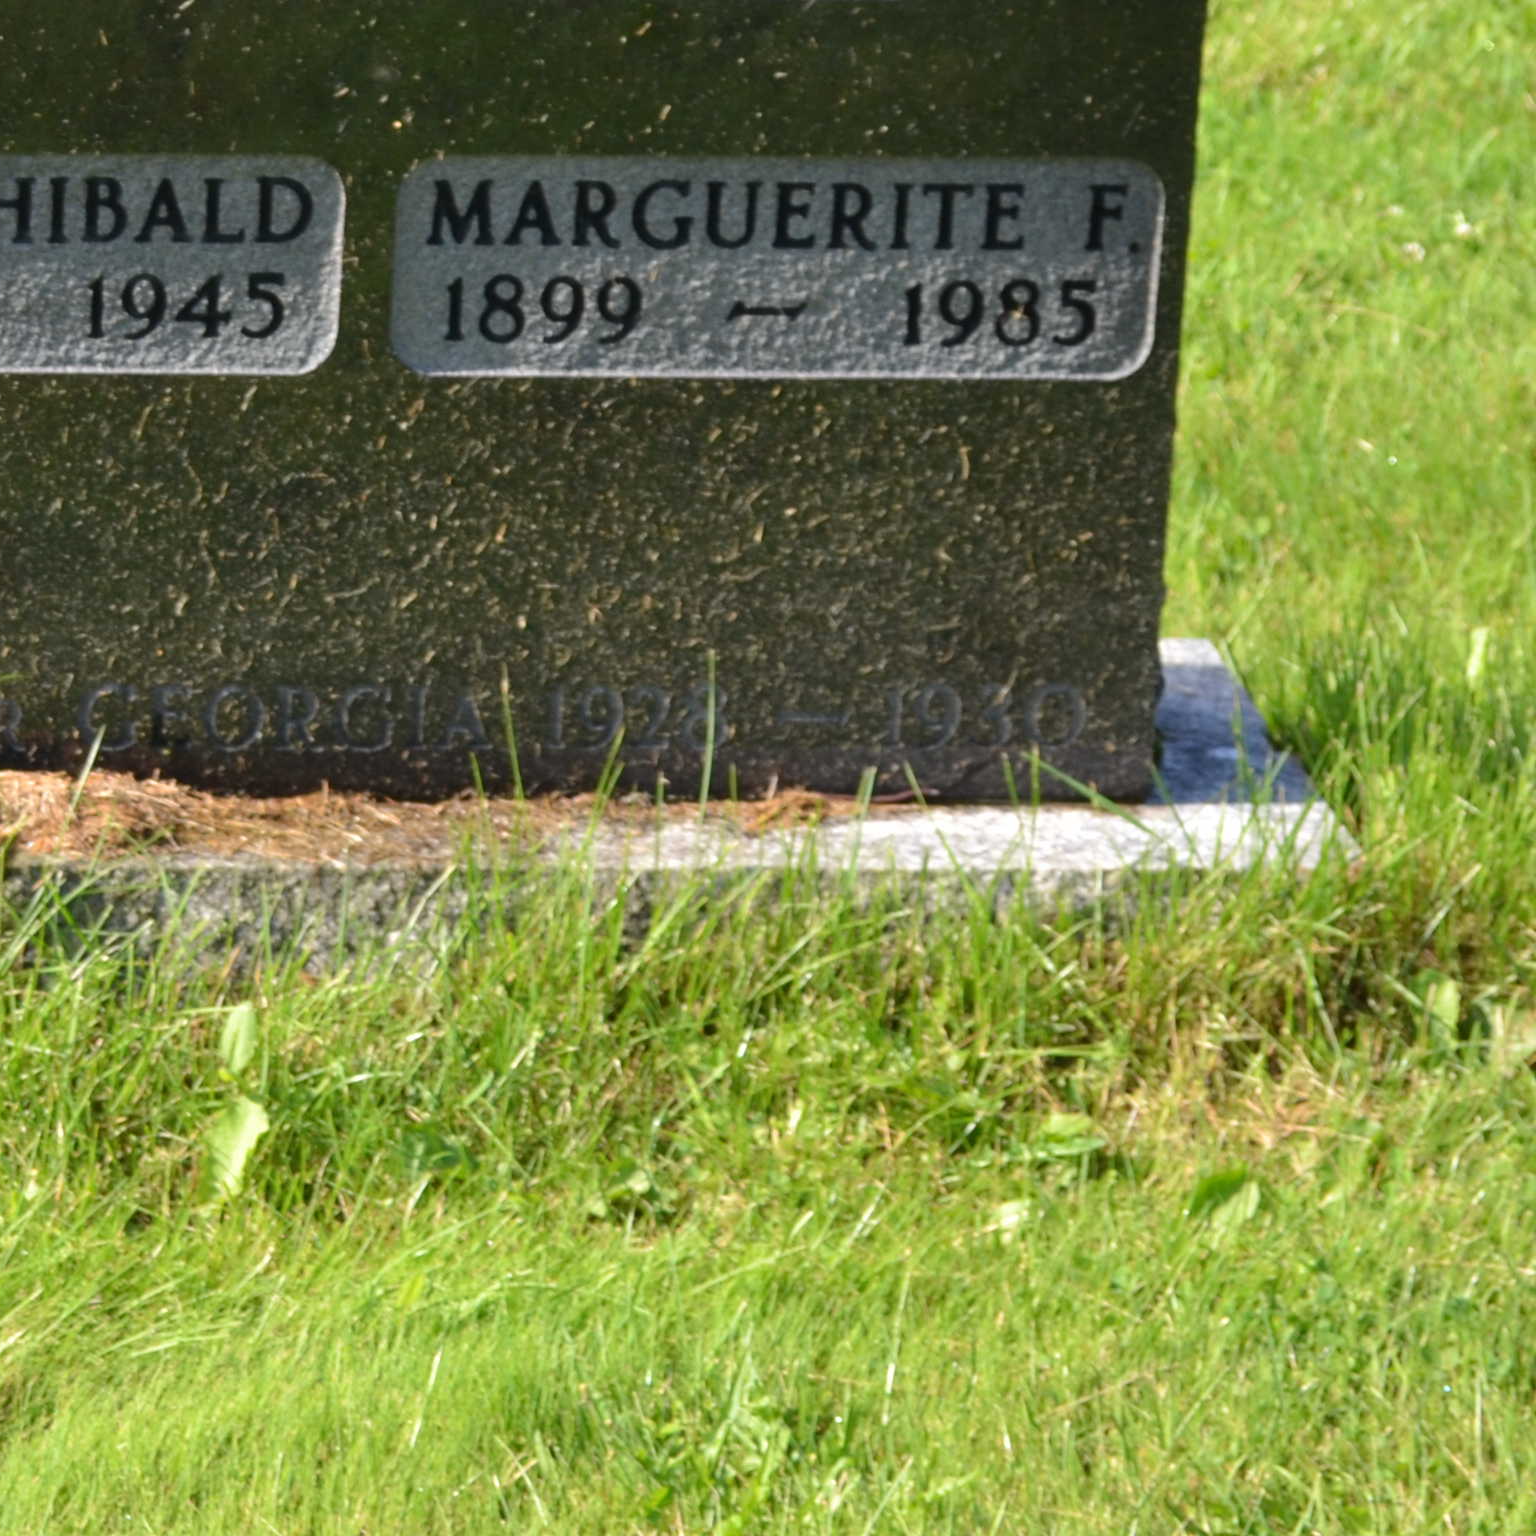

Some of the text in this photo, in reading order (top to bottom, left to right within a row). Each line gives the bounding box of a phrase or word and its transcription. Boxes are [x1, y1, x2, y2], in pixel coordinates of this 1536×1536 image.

[426, 178, 1142, 253] MARGUERITE F.
[87, 271, 288, 340] 1945
[442, 274, 645, 345] 1899
[903, 277, 1099, 348] 1985
